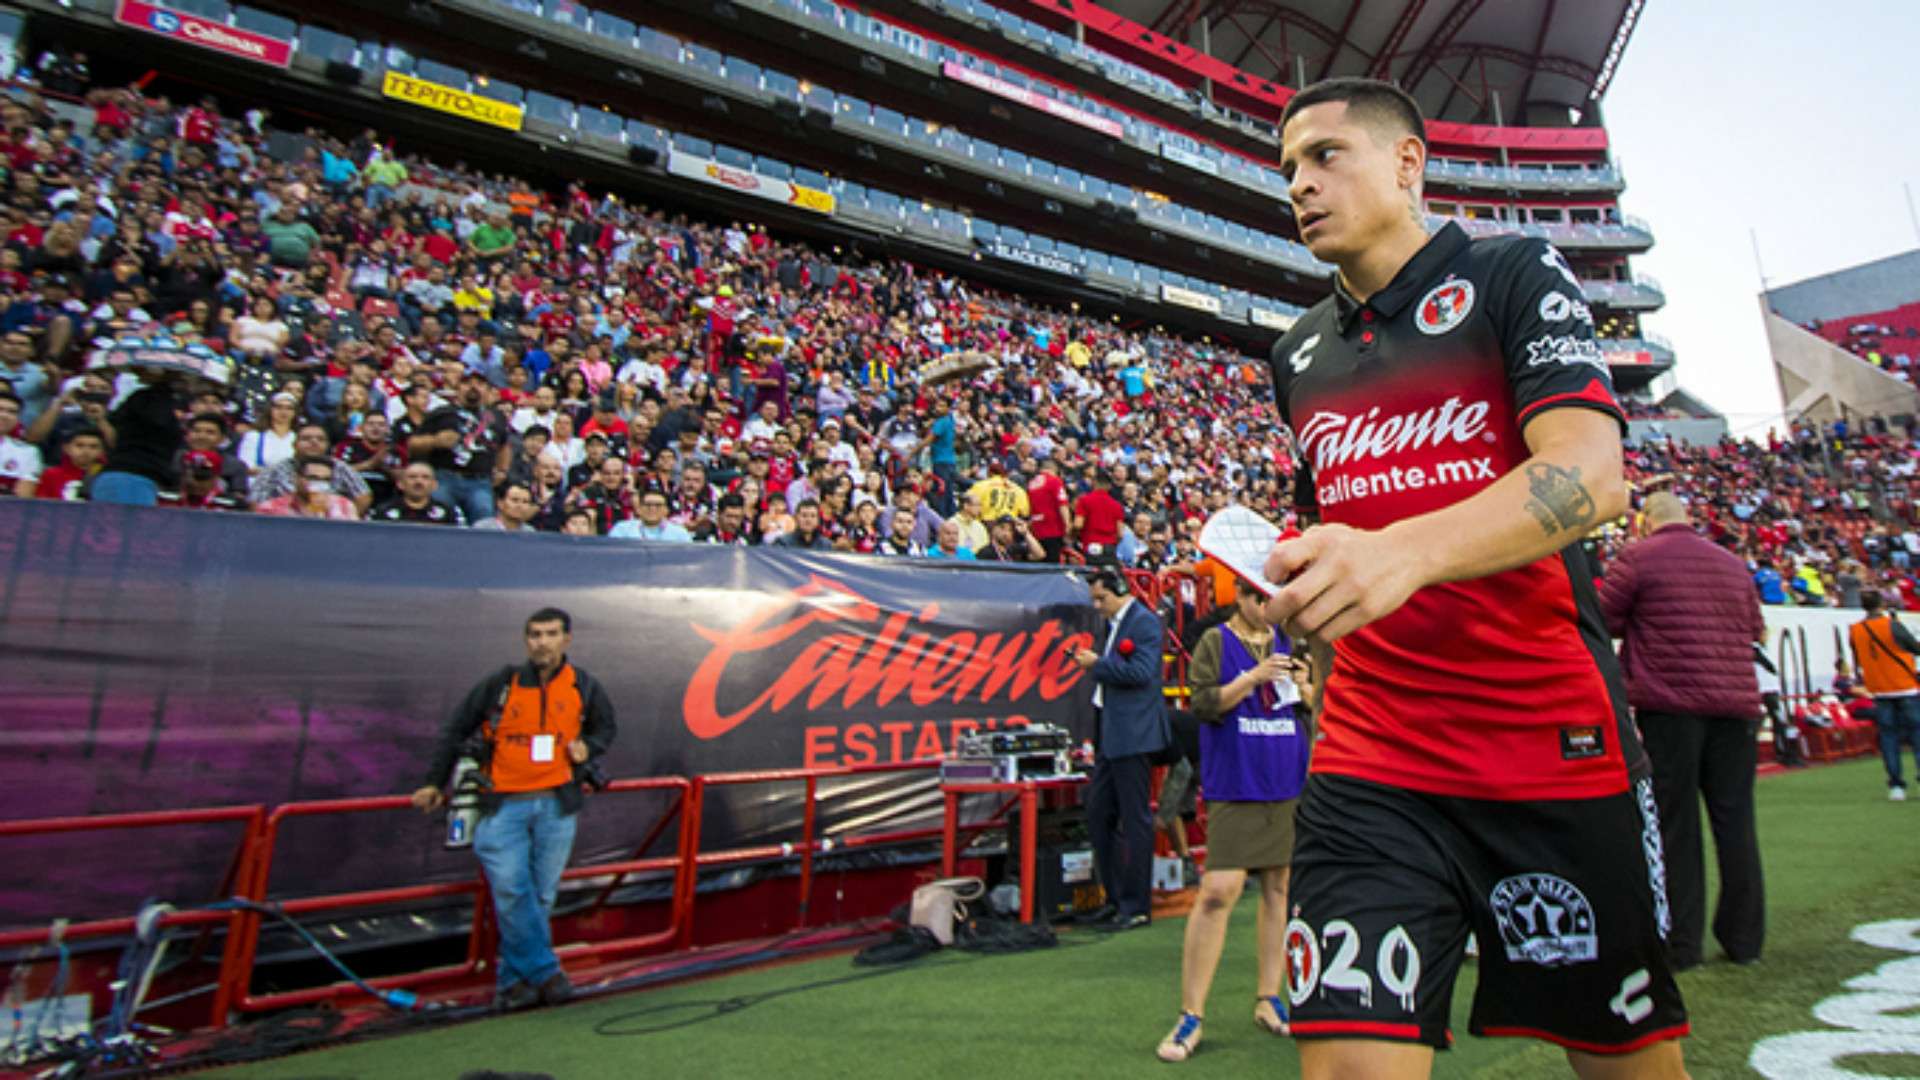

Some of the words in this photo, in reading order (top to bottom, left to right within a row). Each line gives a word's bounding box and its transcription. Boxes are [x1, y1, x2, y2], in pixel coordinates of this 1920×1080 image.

[1299, 395, 1489, 470] Caliente
[1318, 456, 1497, 506] caliente.mx
[683, 573, 1095, 739] Caliente
[803, 714, 1031, 770] ESTA
